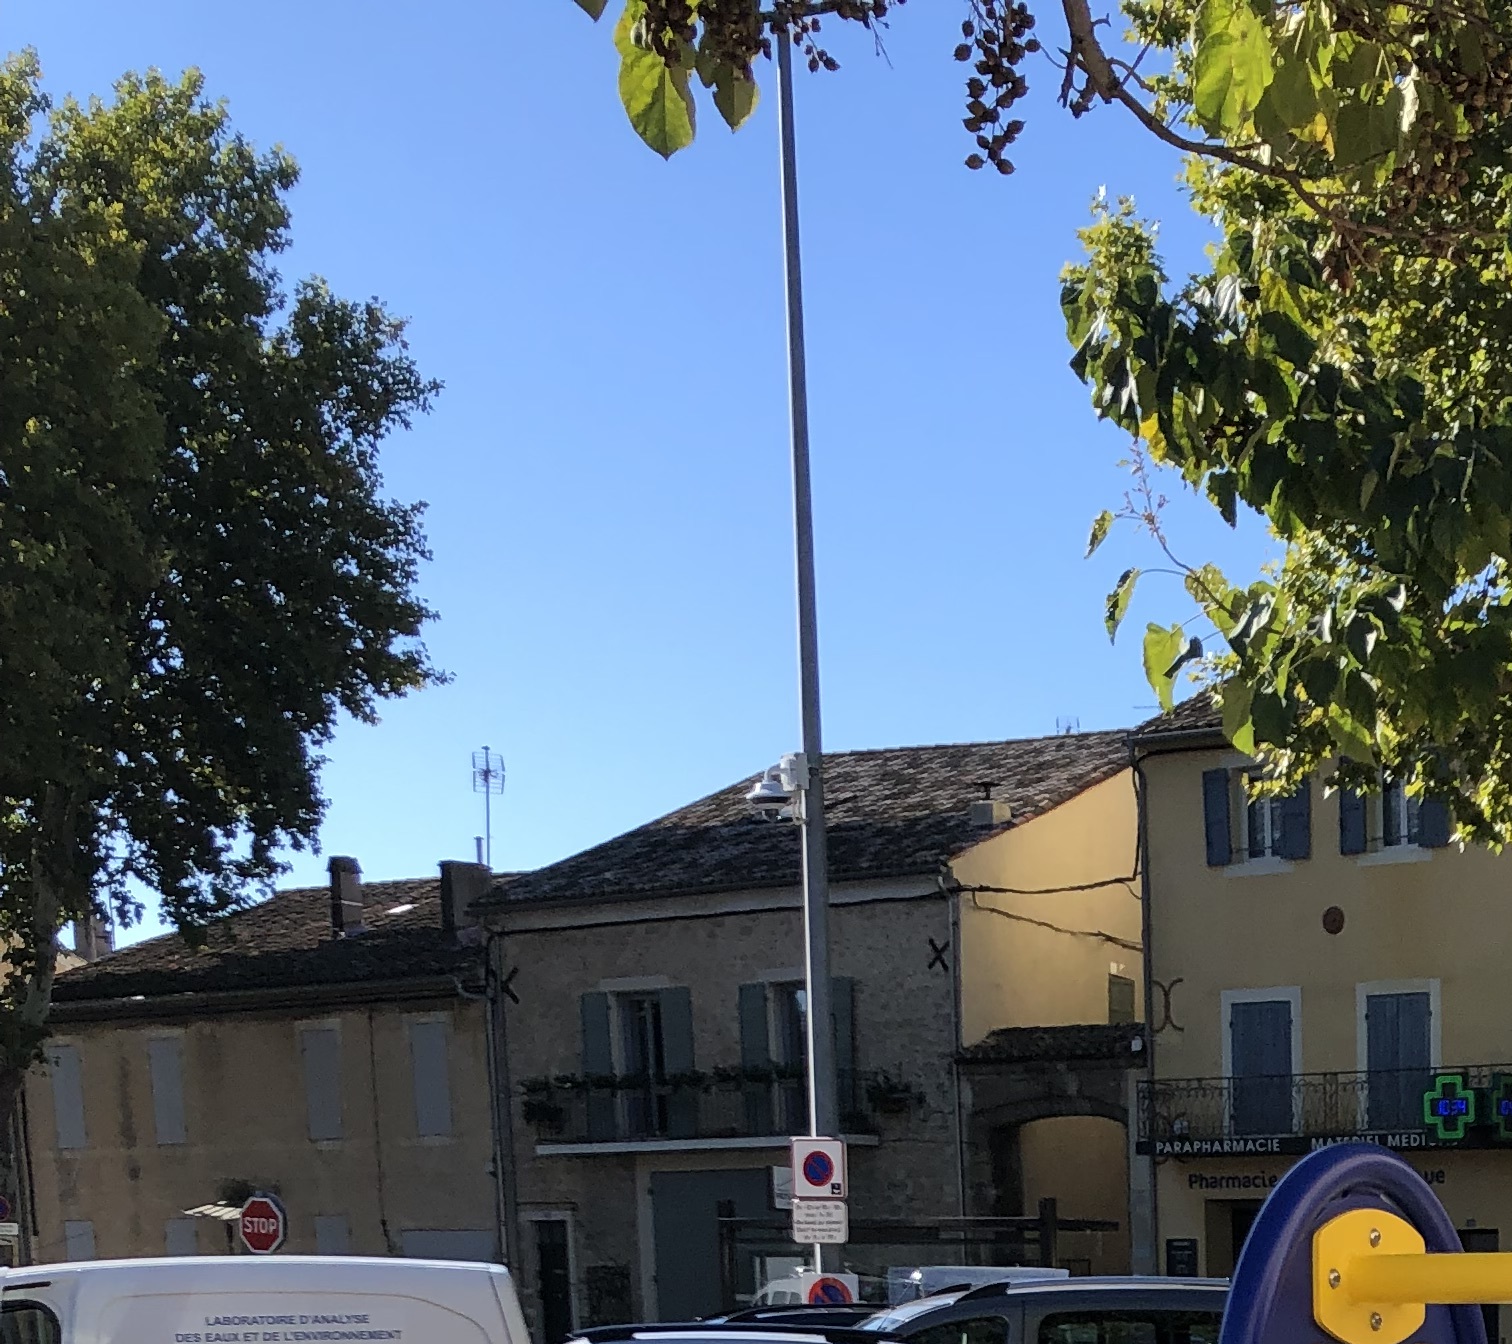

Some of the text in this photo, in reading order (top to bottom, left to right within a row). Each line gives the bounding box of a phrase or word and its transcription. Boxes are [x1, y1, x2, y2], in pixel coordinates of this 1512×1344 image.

[1155, 1138, 1281, 1154] PARAPHARMACIE
[1188, 1171, 1278, 1189] Pharmacie
[243, 1216, 277, 1234] STOP
[205, 1314, 370, 1326] LABORATOIRE D'ANALYSE
[175, 1330, 402, 1343] DES EAUX ET DE L'ENVIRONNEMENT
